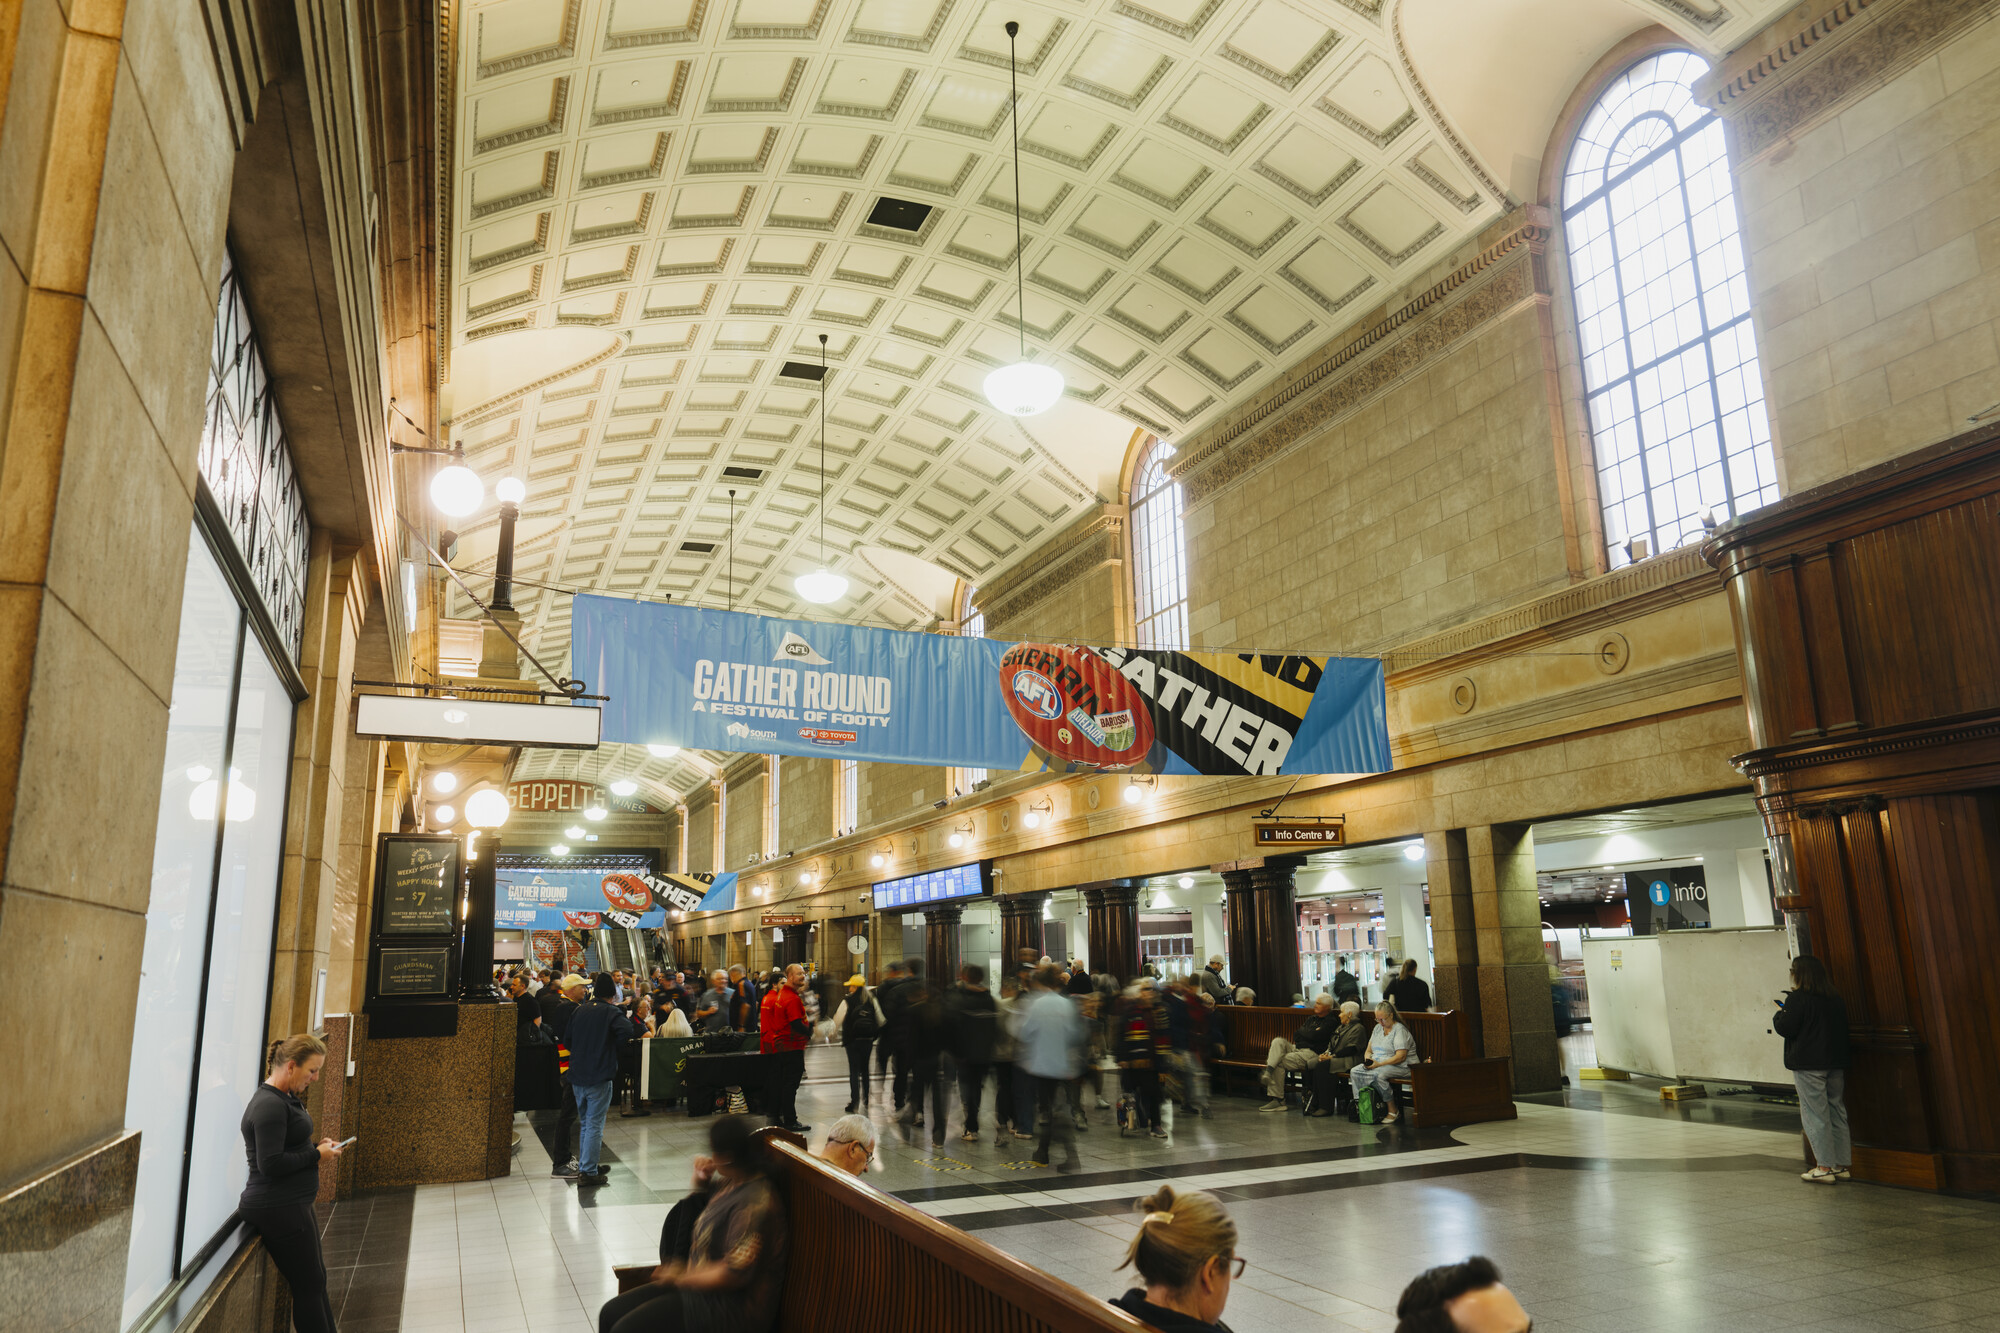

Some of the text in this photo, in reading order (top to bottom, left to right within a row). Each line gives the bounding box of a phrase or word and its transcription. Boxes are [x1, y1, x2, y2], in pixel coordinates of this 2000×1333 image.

[787, 645, 808, 655] AFL
[693, 659, 892, 715] GATHER ROUND
[1015, 676, 1056, 718] AFL
[692, 700, 891, 728] A FESTIVAL OF FOOTY
[1100, 713, 1129, 728] BAROSSA
[750, 729, 777, 739] SOUTH
[1070, 709, 1104, 745] ADELAIDE
[799, 729, 855, 740] AFL TOYOTA
[507, 782, 647, 813] SEPPELT'S WINES
[1275, 830, 1293, 839] Info
[1294, 830, 1322, 840] Centre
[397, 867, 419, 876] WEEKLY
[396, 878, 420, 887] HAPPY
[412, 891, 426, 906] $7
[508, 885, 568, 899] GATHER ROUND
[1674, 882, 1706, 902] info
[680, 1041, 704, 1054] BAR AN
